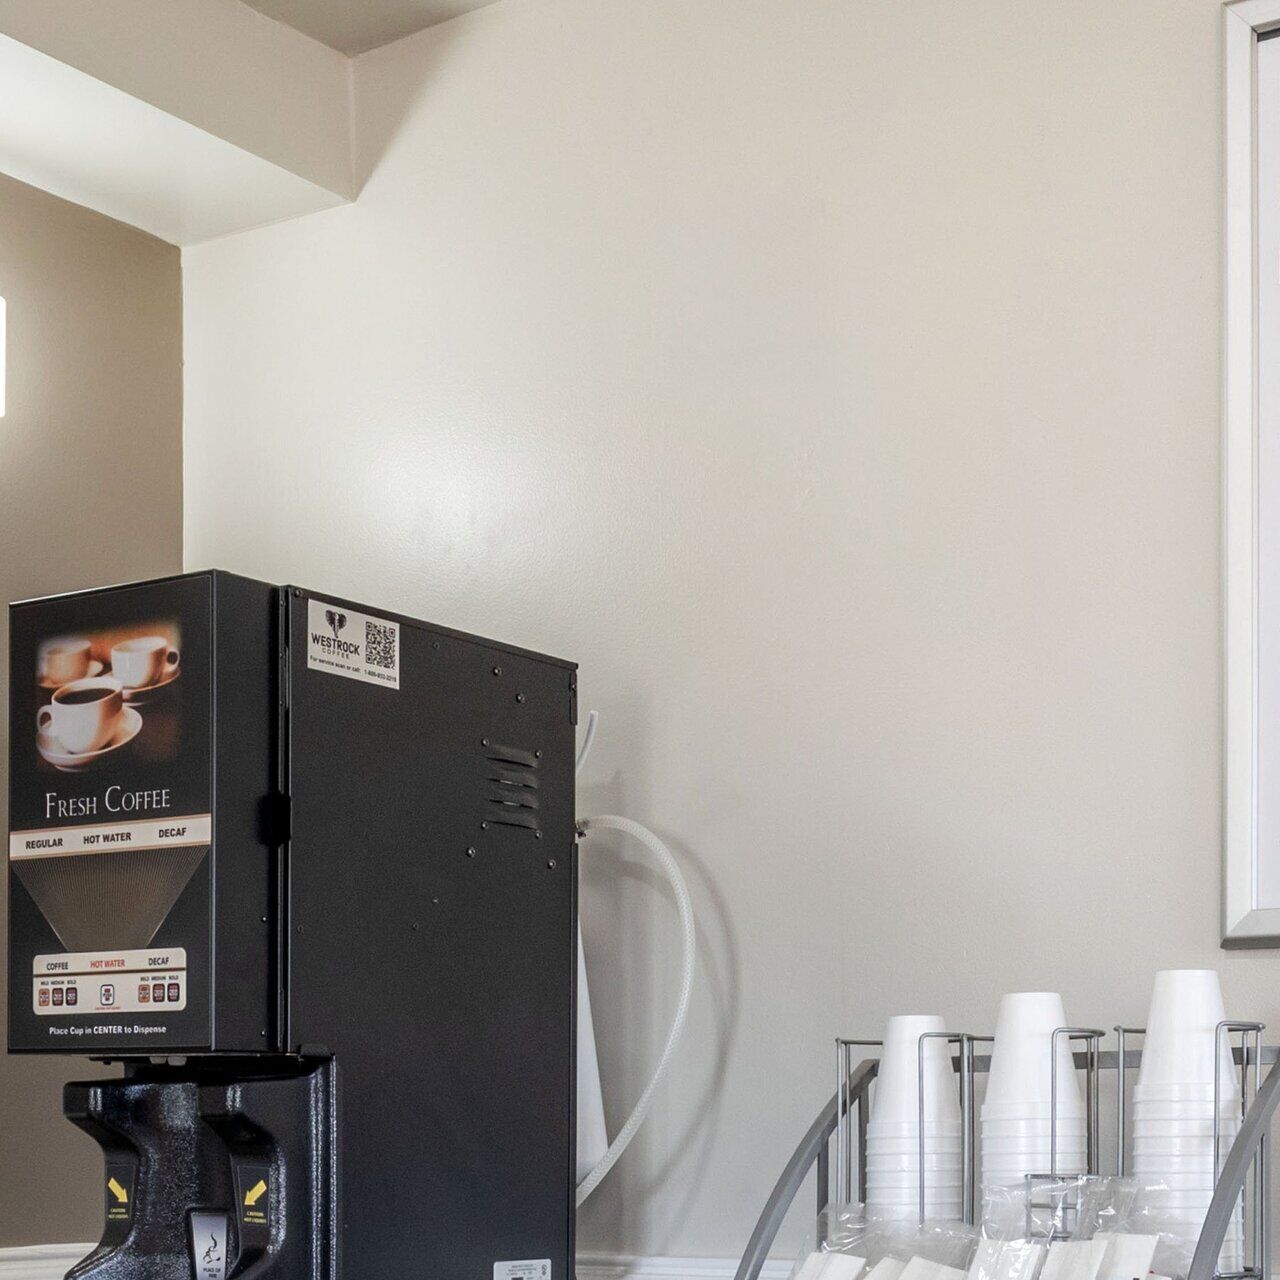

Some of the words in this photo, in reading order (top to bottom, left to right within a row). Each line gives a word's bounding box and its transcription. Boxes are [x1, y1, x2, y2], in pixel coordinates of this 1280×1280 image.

[311, 632, 360, 656] WESTROCK
[322, 647, 349, 659] COFFEE
[45, 792, 97, 818] FRESH
[105, 786, 170, 812] COFFEE
[25, 838, 63, 849] REGULAR
[83, 835, 100, 844] HOT
[102, 832, 132, 842] WATER
[158, 827, 187, 838] DECAF
[46, 962, 68, 970] COFFEE
[90, 960, 104, 968] HOT
[104, 959, 125, 967] WATER
[148, 957, 169, 965] DECAF
[49, 1026, 68, 1034] Place
[70, 1026, 84, 1036] Cup
[93, 1025, 122, 1034] CENTER
[133, 1025, 166, 1035] Dispense
